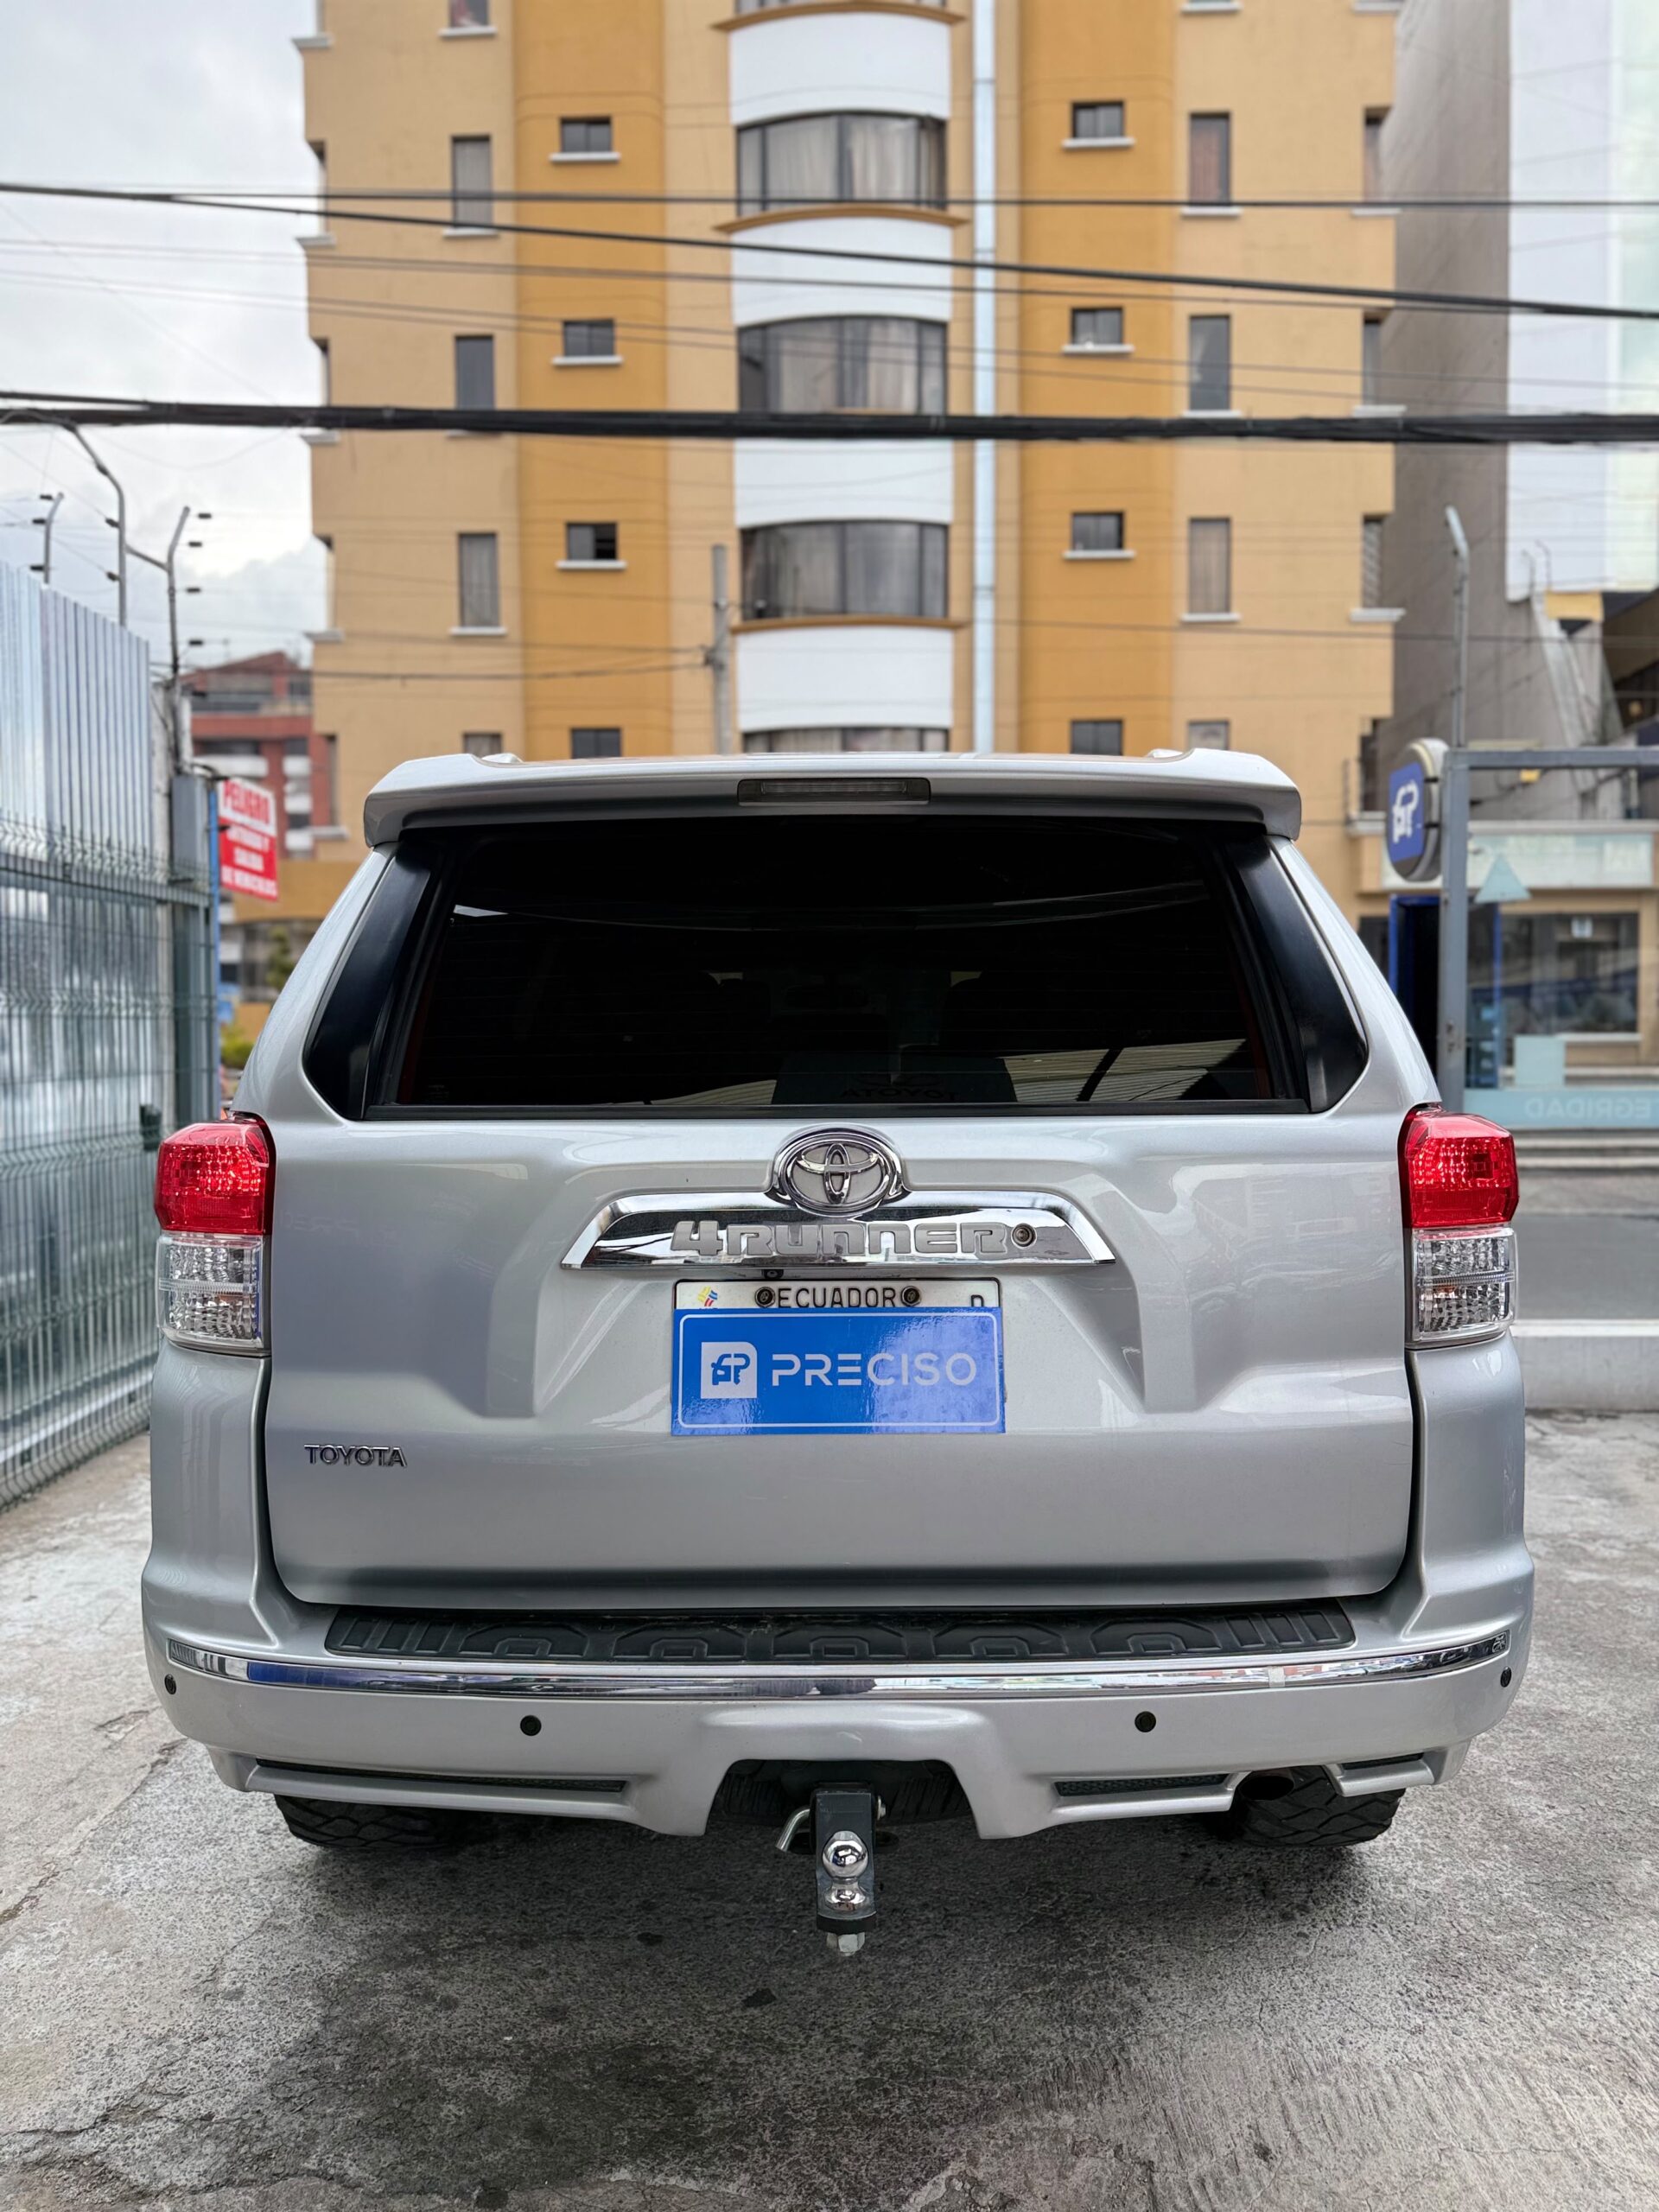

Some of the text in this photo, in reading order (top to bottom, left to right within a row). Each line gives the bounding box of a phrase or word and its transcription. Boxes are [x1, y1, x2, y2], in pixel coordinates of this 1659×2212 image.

[670, 1220, 1007, 1257] 4RUNNER
[778, 1287, 896, 1308] ECUADOR
[772, 1344, 977, 1386] PRECISO
[304, 1444, 407, 1467] TOYOTA
